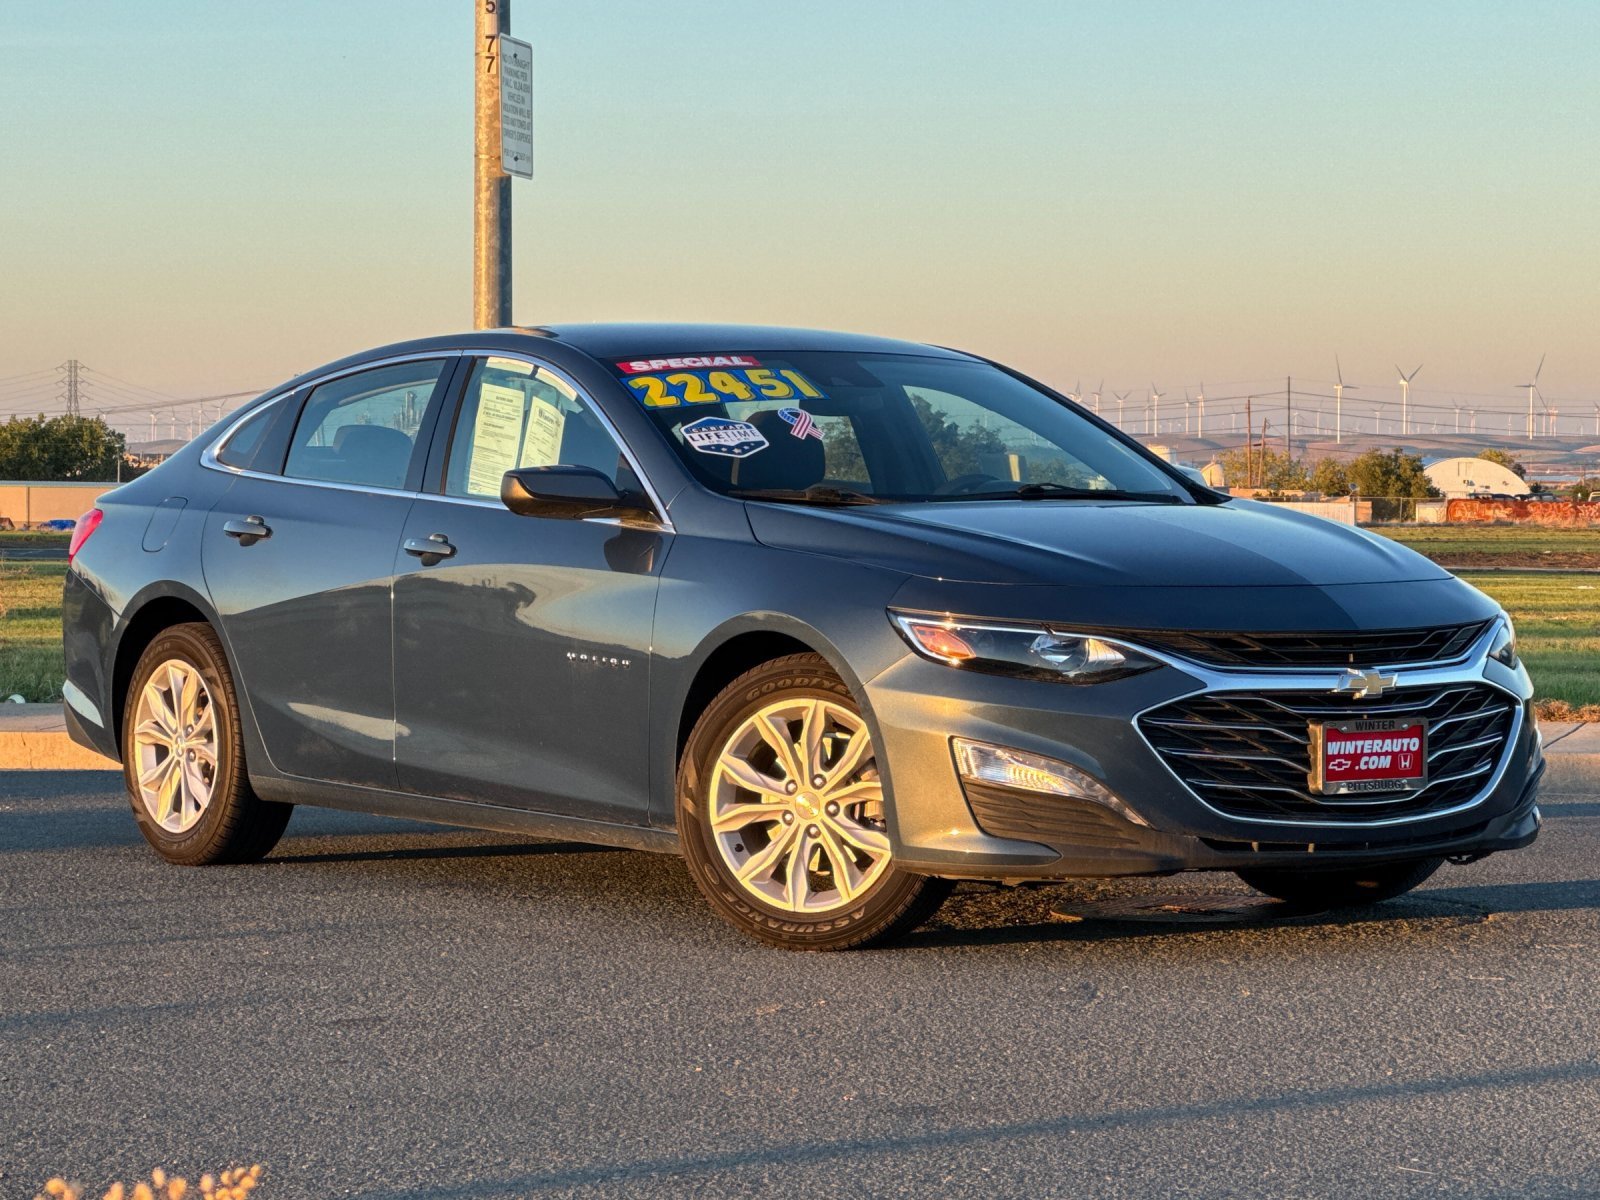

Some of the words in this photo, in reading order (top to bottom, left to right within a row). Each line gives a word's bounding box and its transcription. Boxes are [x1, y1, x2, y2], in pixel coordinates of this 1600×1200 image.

[629, 356, 753, 371] SPECIAL
[628, 369, 824, 407] 22451
[688, 429, 760, 442] LIFETIME
[690, 423, 745, 434] CARFAX
[1355, 720, 1395, 731] WINTER
[1327, 737, 1420, 756] WINTERAUTO
[1355, 755, 1392, 770] .COM
[1347, 779, 1401, 791] PITTSBURG
[722, 891, 865, 933] ASSURANCE
